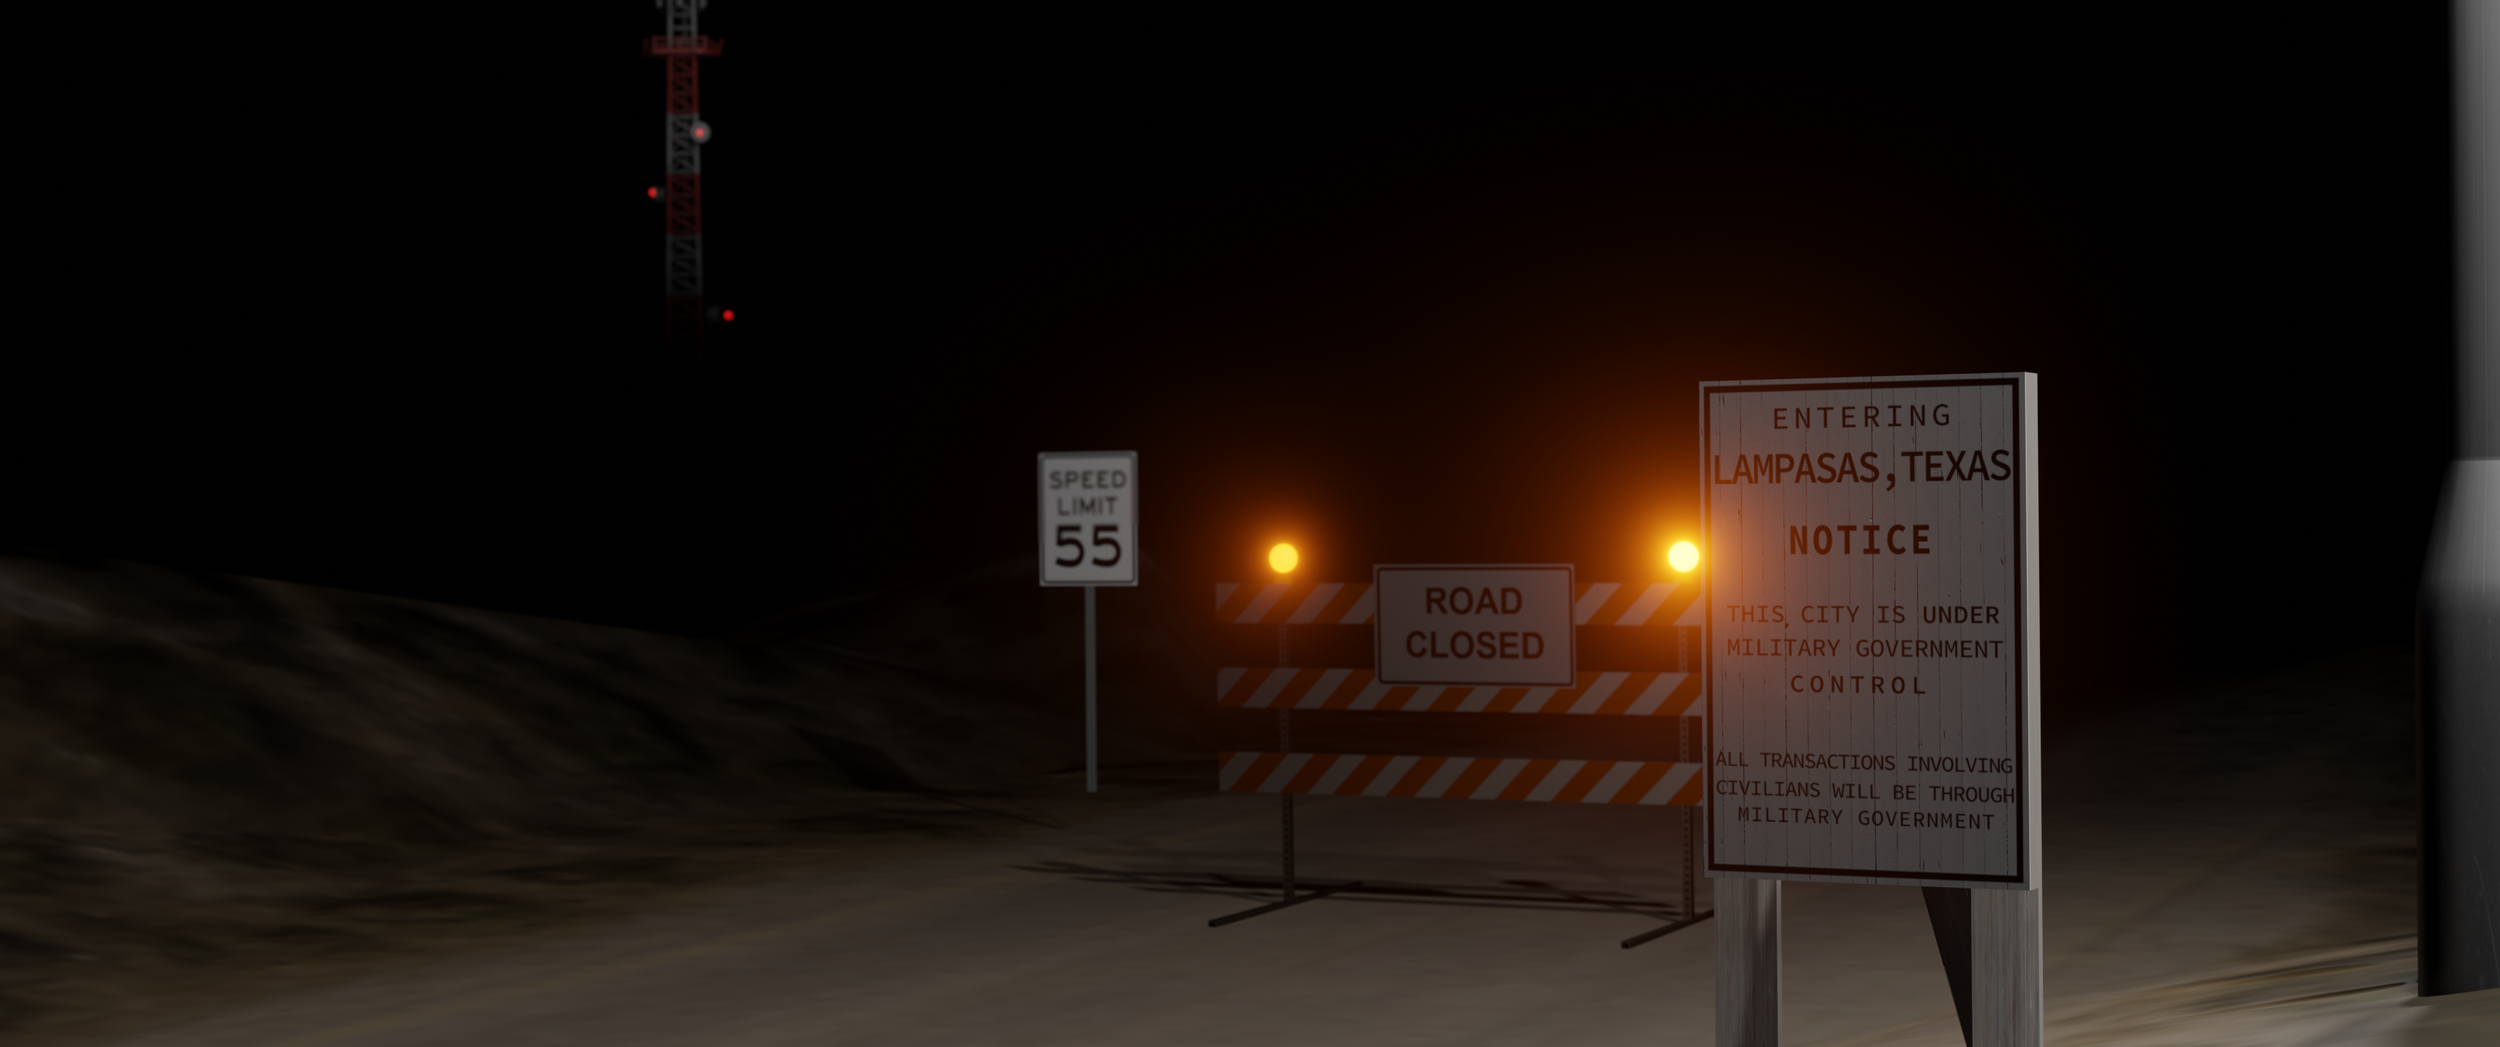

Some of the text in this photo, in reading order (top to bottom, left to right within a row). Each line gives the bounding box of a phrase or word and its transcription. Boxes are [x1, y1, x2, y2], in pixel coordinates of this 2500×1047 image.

[1774, 404, 1950, 429] ENTERING
[1049, 470, 1127, 490] SPEED
[1058, 496, 1117, 516] LIMIT
[1055, 525, 1122, 568] 55
[1790, 524, 1930, 555] NOTICE
[1426, 587, 1522, 615] ROAD
[1726, 605, 2000, 624] THIS CITY IS UNDER
[1406, 631, 1544, 659] CLOSED
[1727, 638, 2003, 658] MILITARY GOVERNMENT
[1790, 675, 1925, 694] CONTROL
[1716, 752, 2013, 773] ALL TRANSACTIONS INVOLVING
[1716, 780, 2015, 804] CIVILIANS WILL BE THROUGH
[1738, 807, 1995, 830] MILITARY GOVERNMENT
